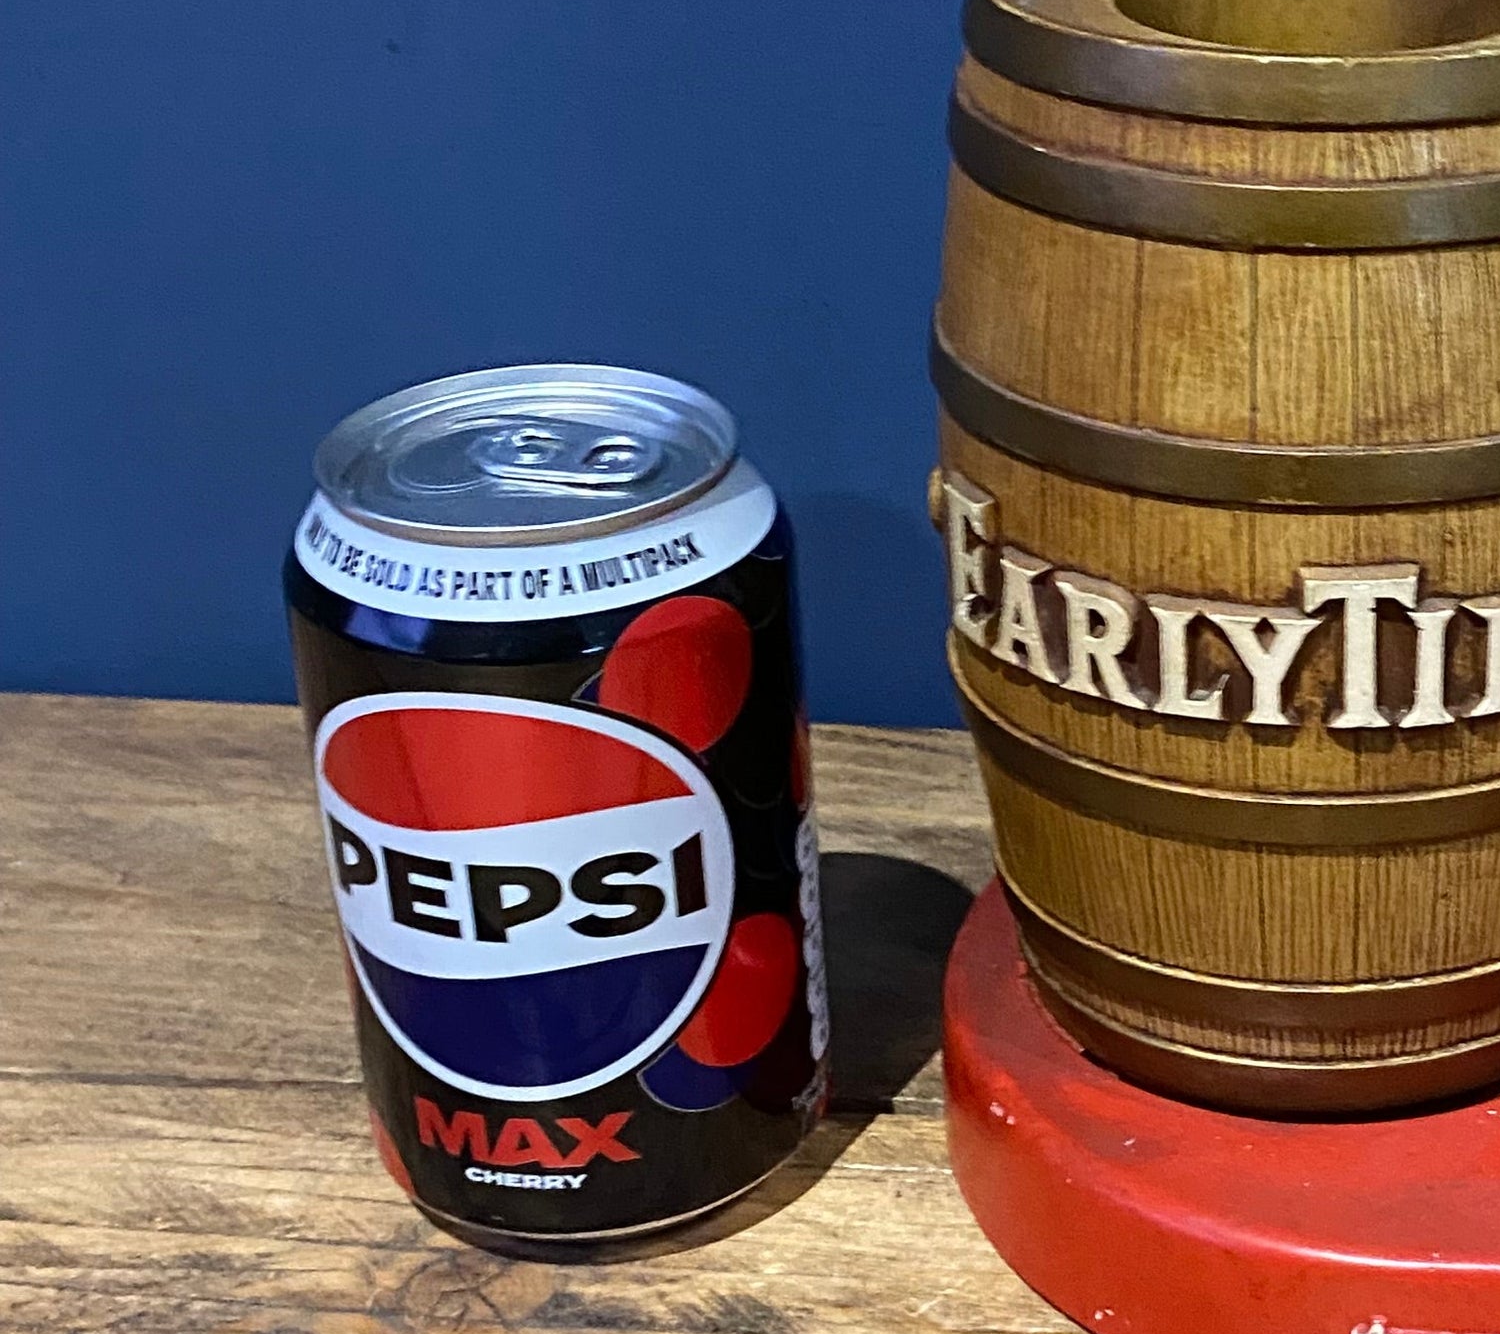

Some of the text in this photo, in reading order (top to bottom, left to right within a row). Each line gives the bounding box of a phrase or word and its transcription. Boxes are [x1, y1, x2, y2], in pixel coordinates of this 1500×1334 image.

[339, 544, 364, 578] BE
[363, 553, 409, 592] SOLD
[416, 566, 446, 598] AS
[451, 570, 513, 600] PART
[523, 569, 550, 599] OF
[559, 566, 579, 596] A
[580, 532, 706, 592] MULTIPACK
[327, 810, 708, 943] PEPSI
[413, 1095, 642, 1169] MAX
[465, 1166, 588, 1190] CHERRY
